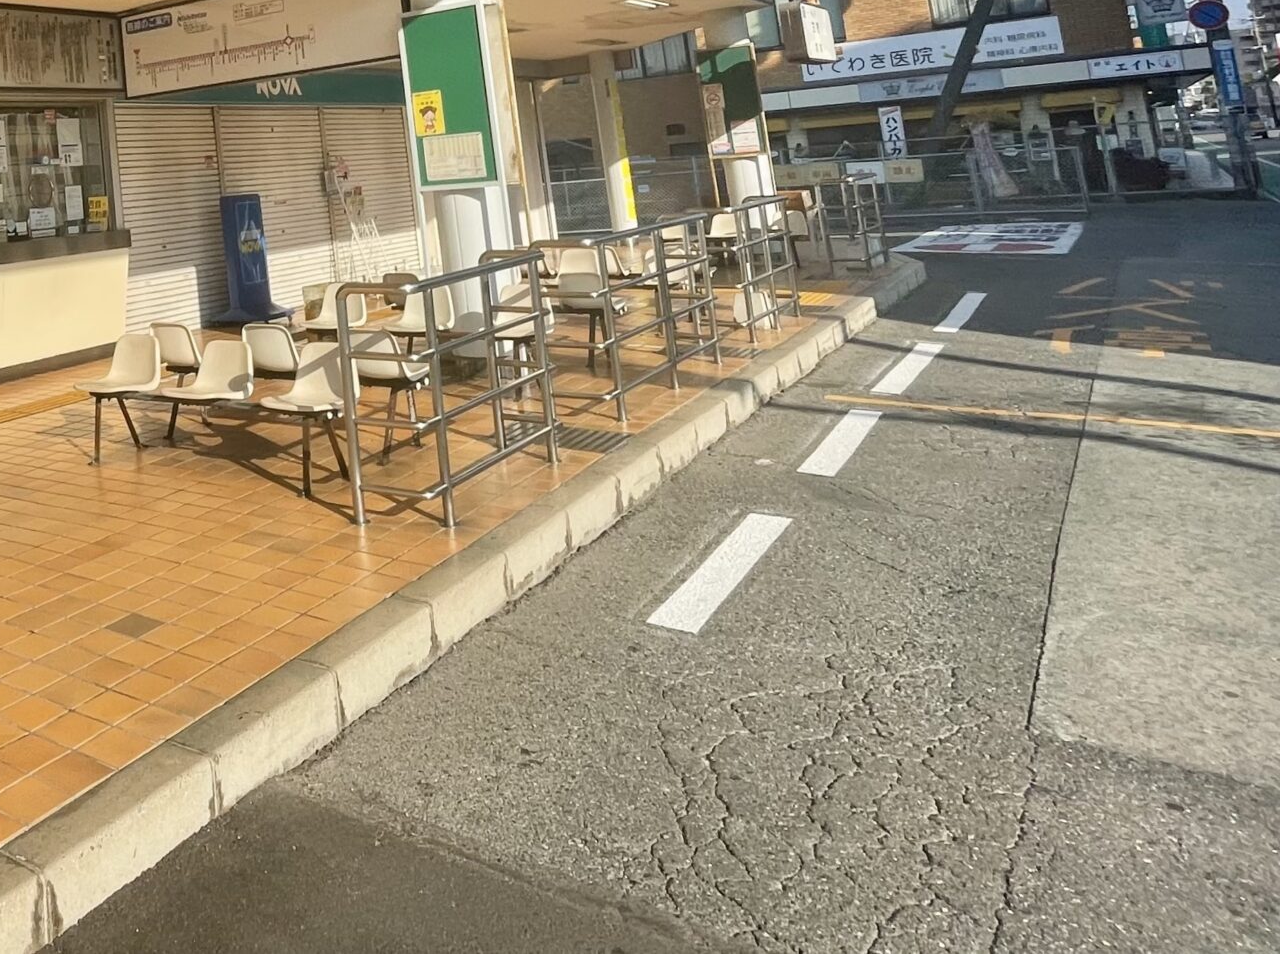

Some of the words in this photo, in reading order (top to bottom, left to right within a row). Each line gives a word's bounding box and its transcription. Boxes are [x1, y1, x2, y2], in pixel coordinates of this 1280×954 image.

[1115, 59, 1156, 72] エイト
[256, 77, 303, 98] NOVA
